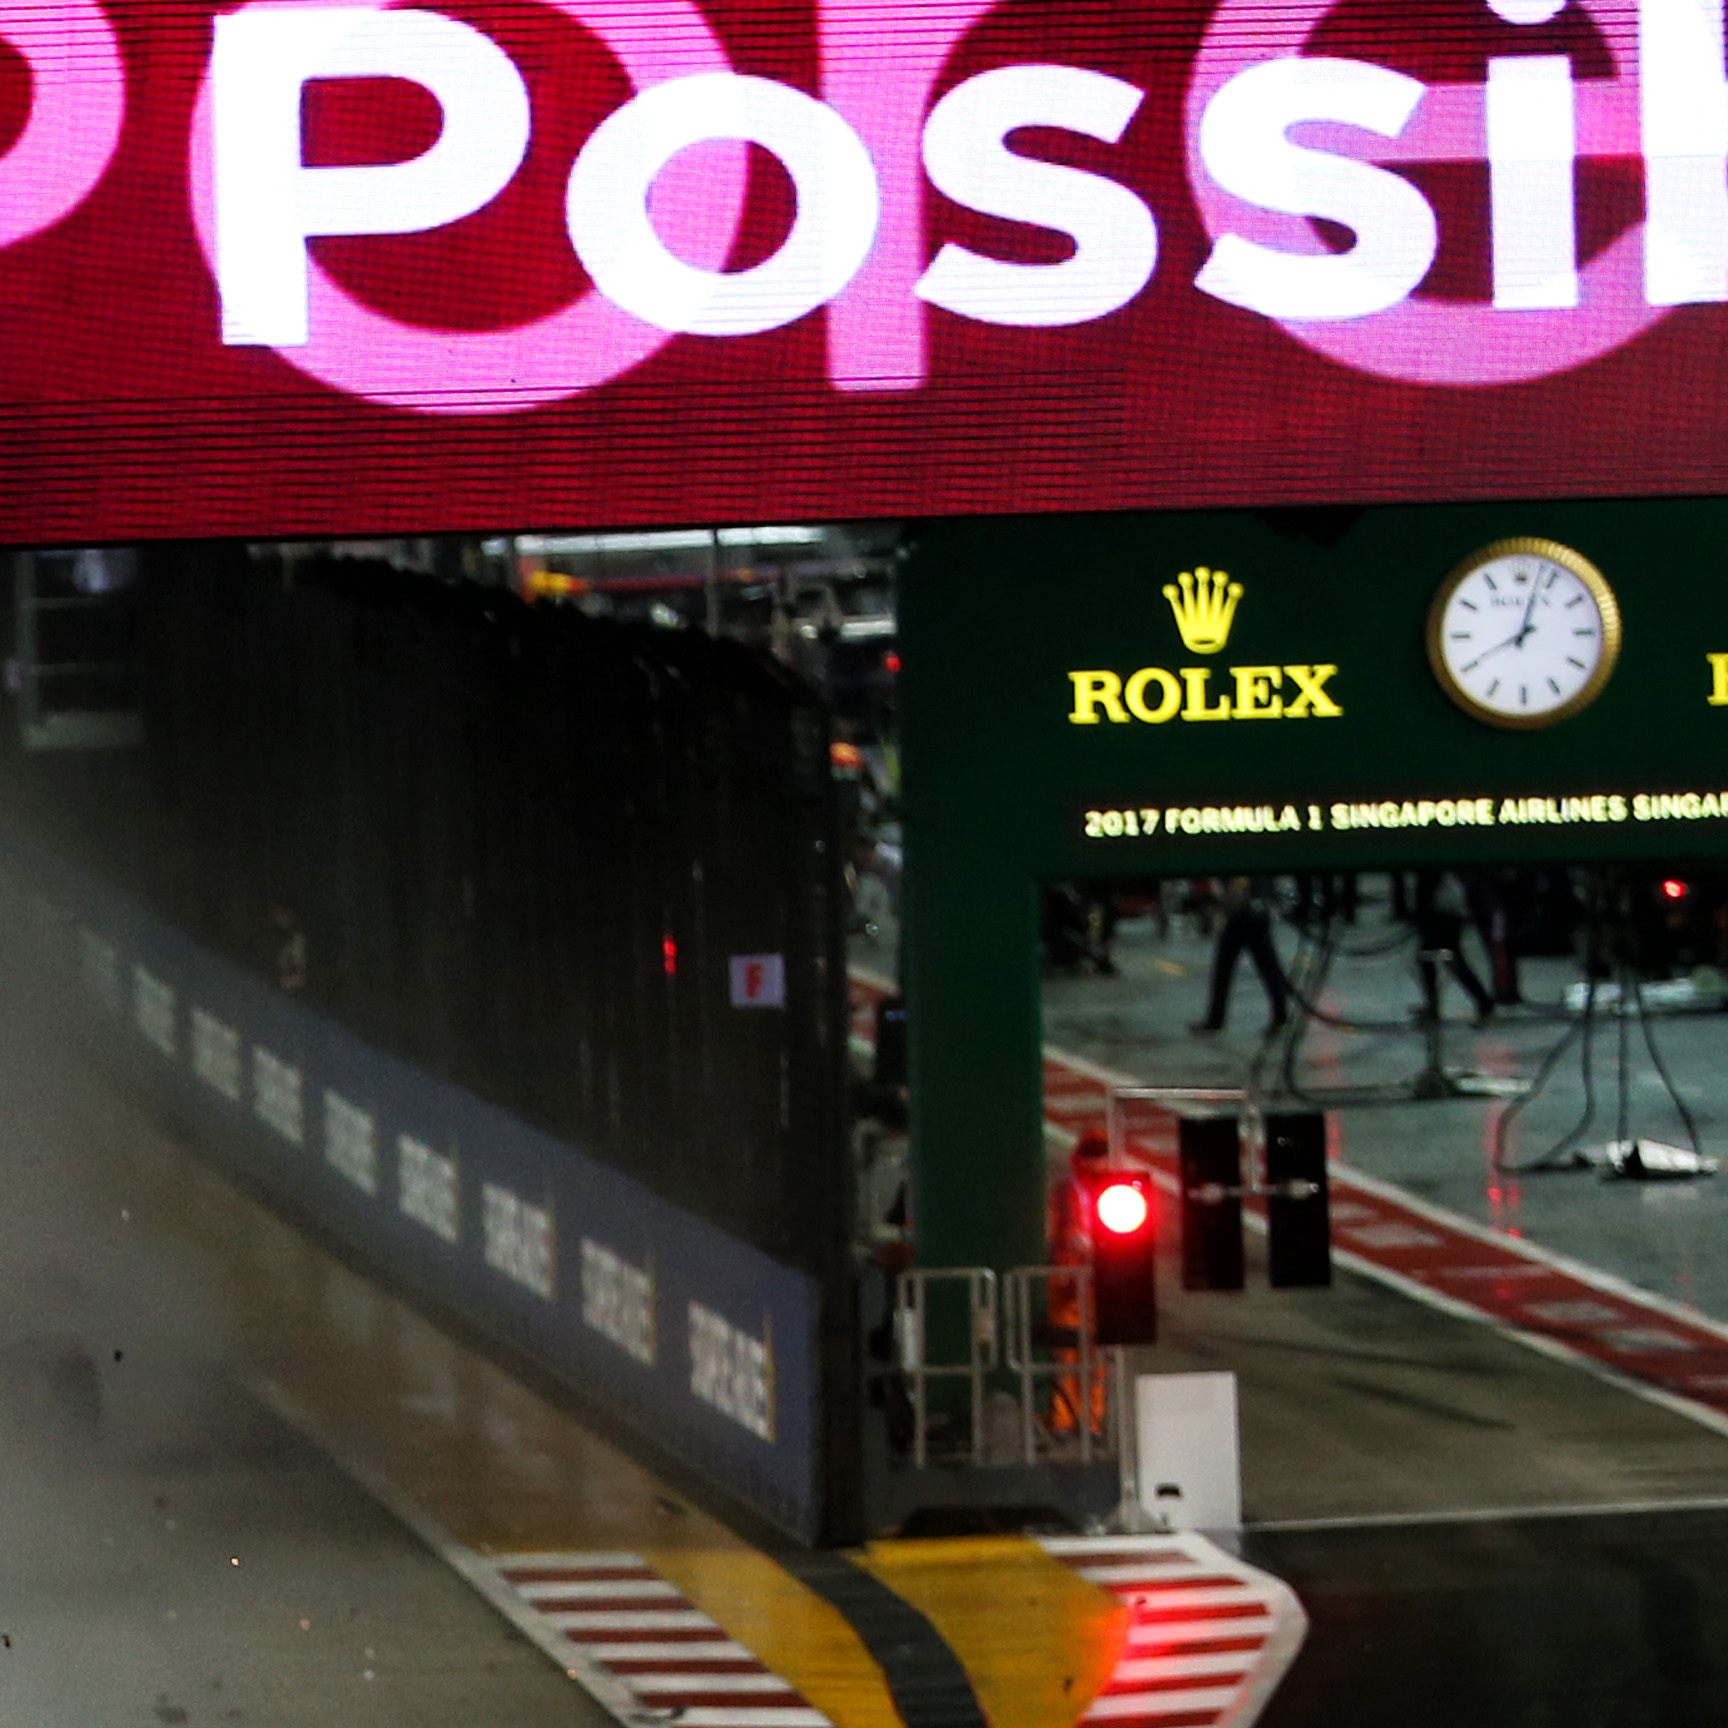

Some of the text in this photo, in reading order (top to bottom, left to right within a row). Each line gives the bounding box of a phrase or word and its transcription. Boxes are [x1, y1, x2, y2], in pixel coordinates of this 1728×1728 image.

[1068, 664, 1343, 724] ROLEX
[1084, 810, 1161, 838] 2017
[1164, 805, 1302, 835] FORMULA
[1307, 804, 1324, 832] 1
[1330, 799, 1495, 832] SINGAPORE
[1498, 797, 1628, 825] AIRLINES
